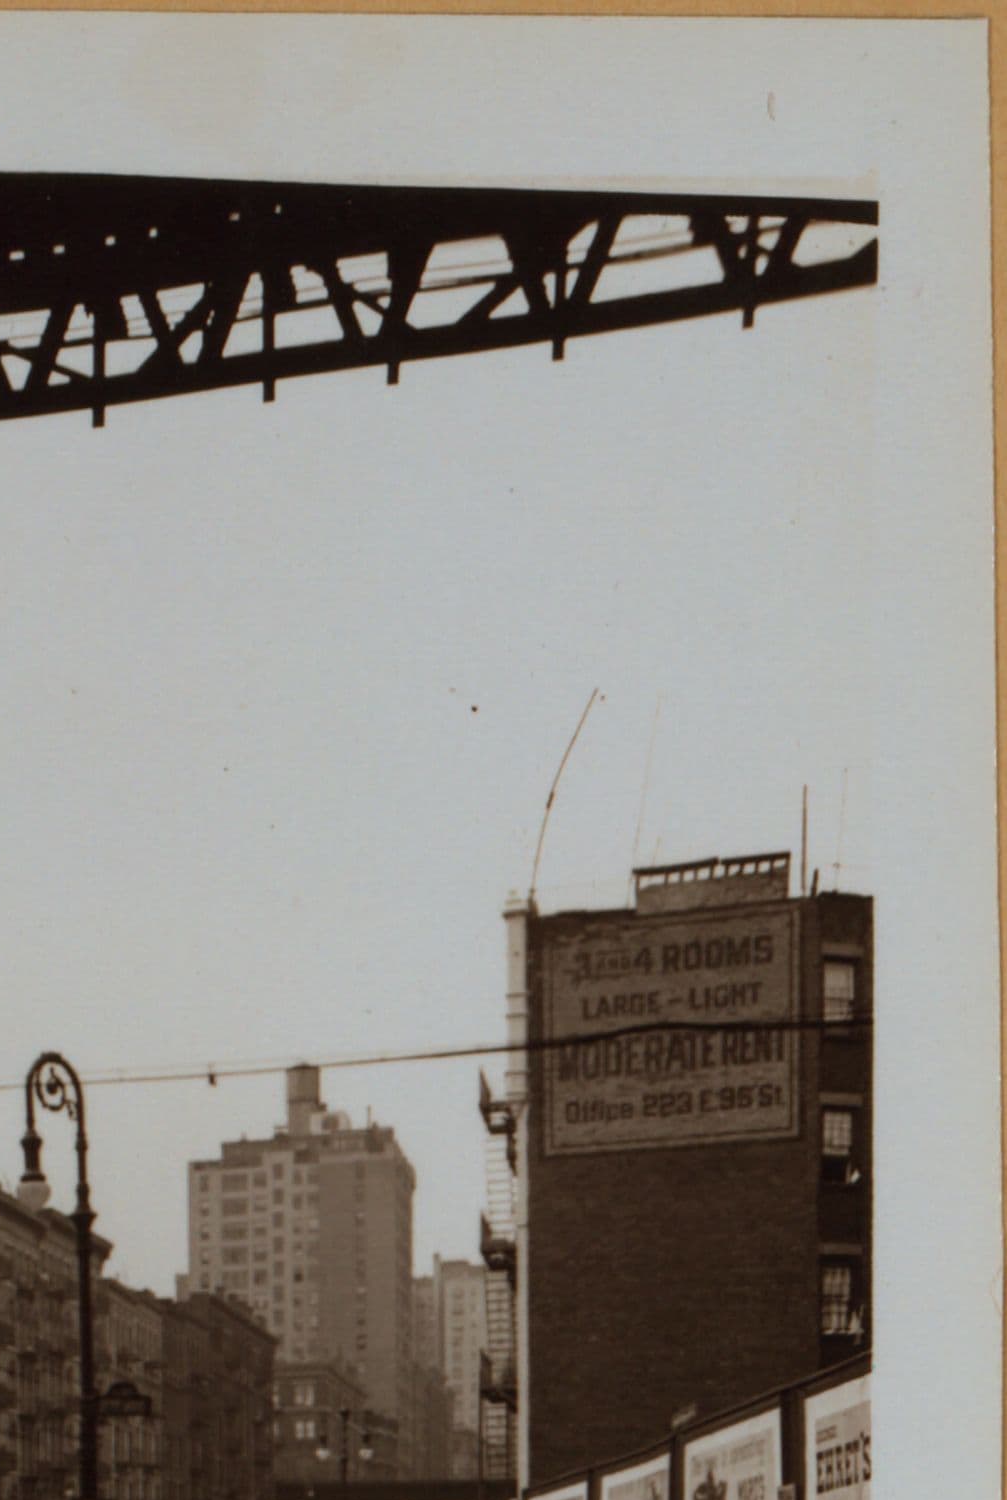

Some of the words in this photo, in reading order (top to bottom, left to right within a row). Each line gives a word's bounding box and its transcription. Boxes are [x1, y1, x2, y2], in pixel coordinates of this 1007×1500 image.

[632, 946, 653, 974] 4
[662, 935, 774, 973] ROOMS
[581, 991, 661, 1020] LARGE
[688, 981, 763, 1011] LIGHT
[557, 1031, 716, 1081] MODERATE
[721, 1028, 785, 1066] RENT
[565, 1098, 634, 1124] Office
[642, 1091, 693, 1117] 223
